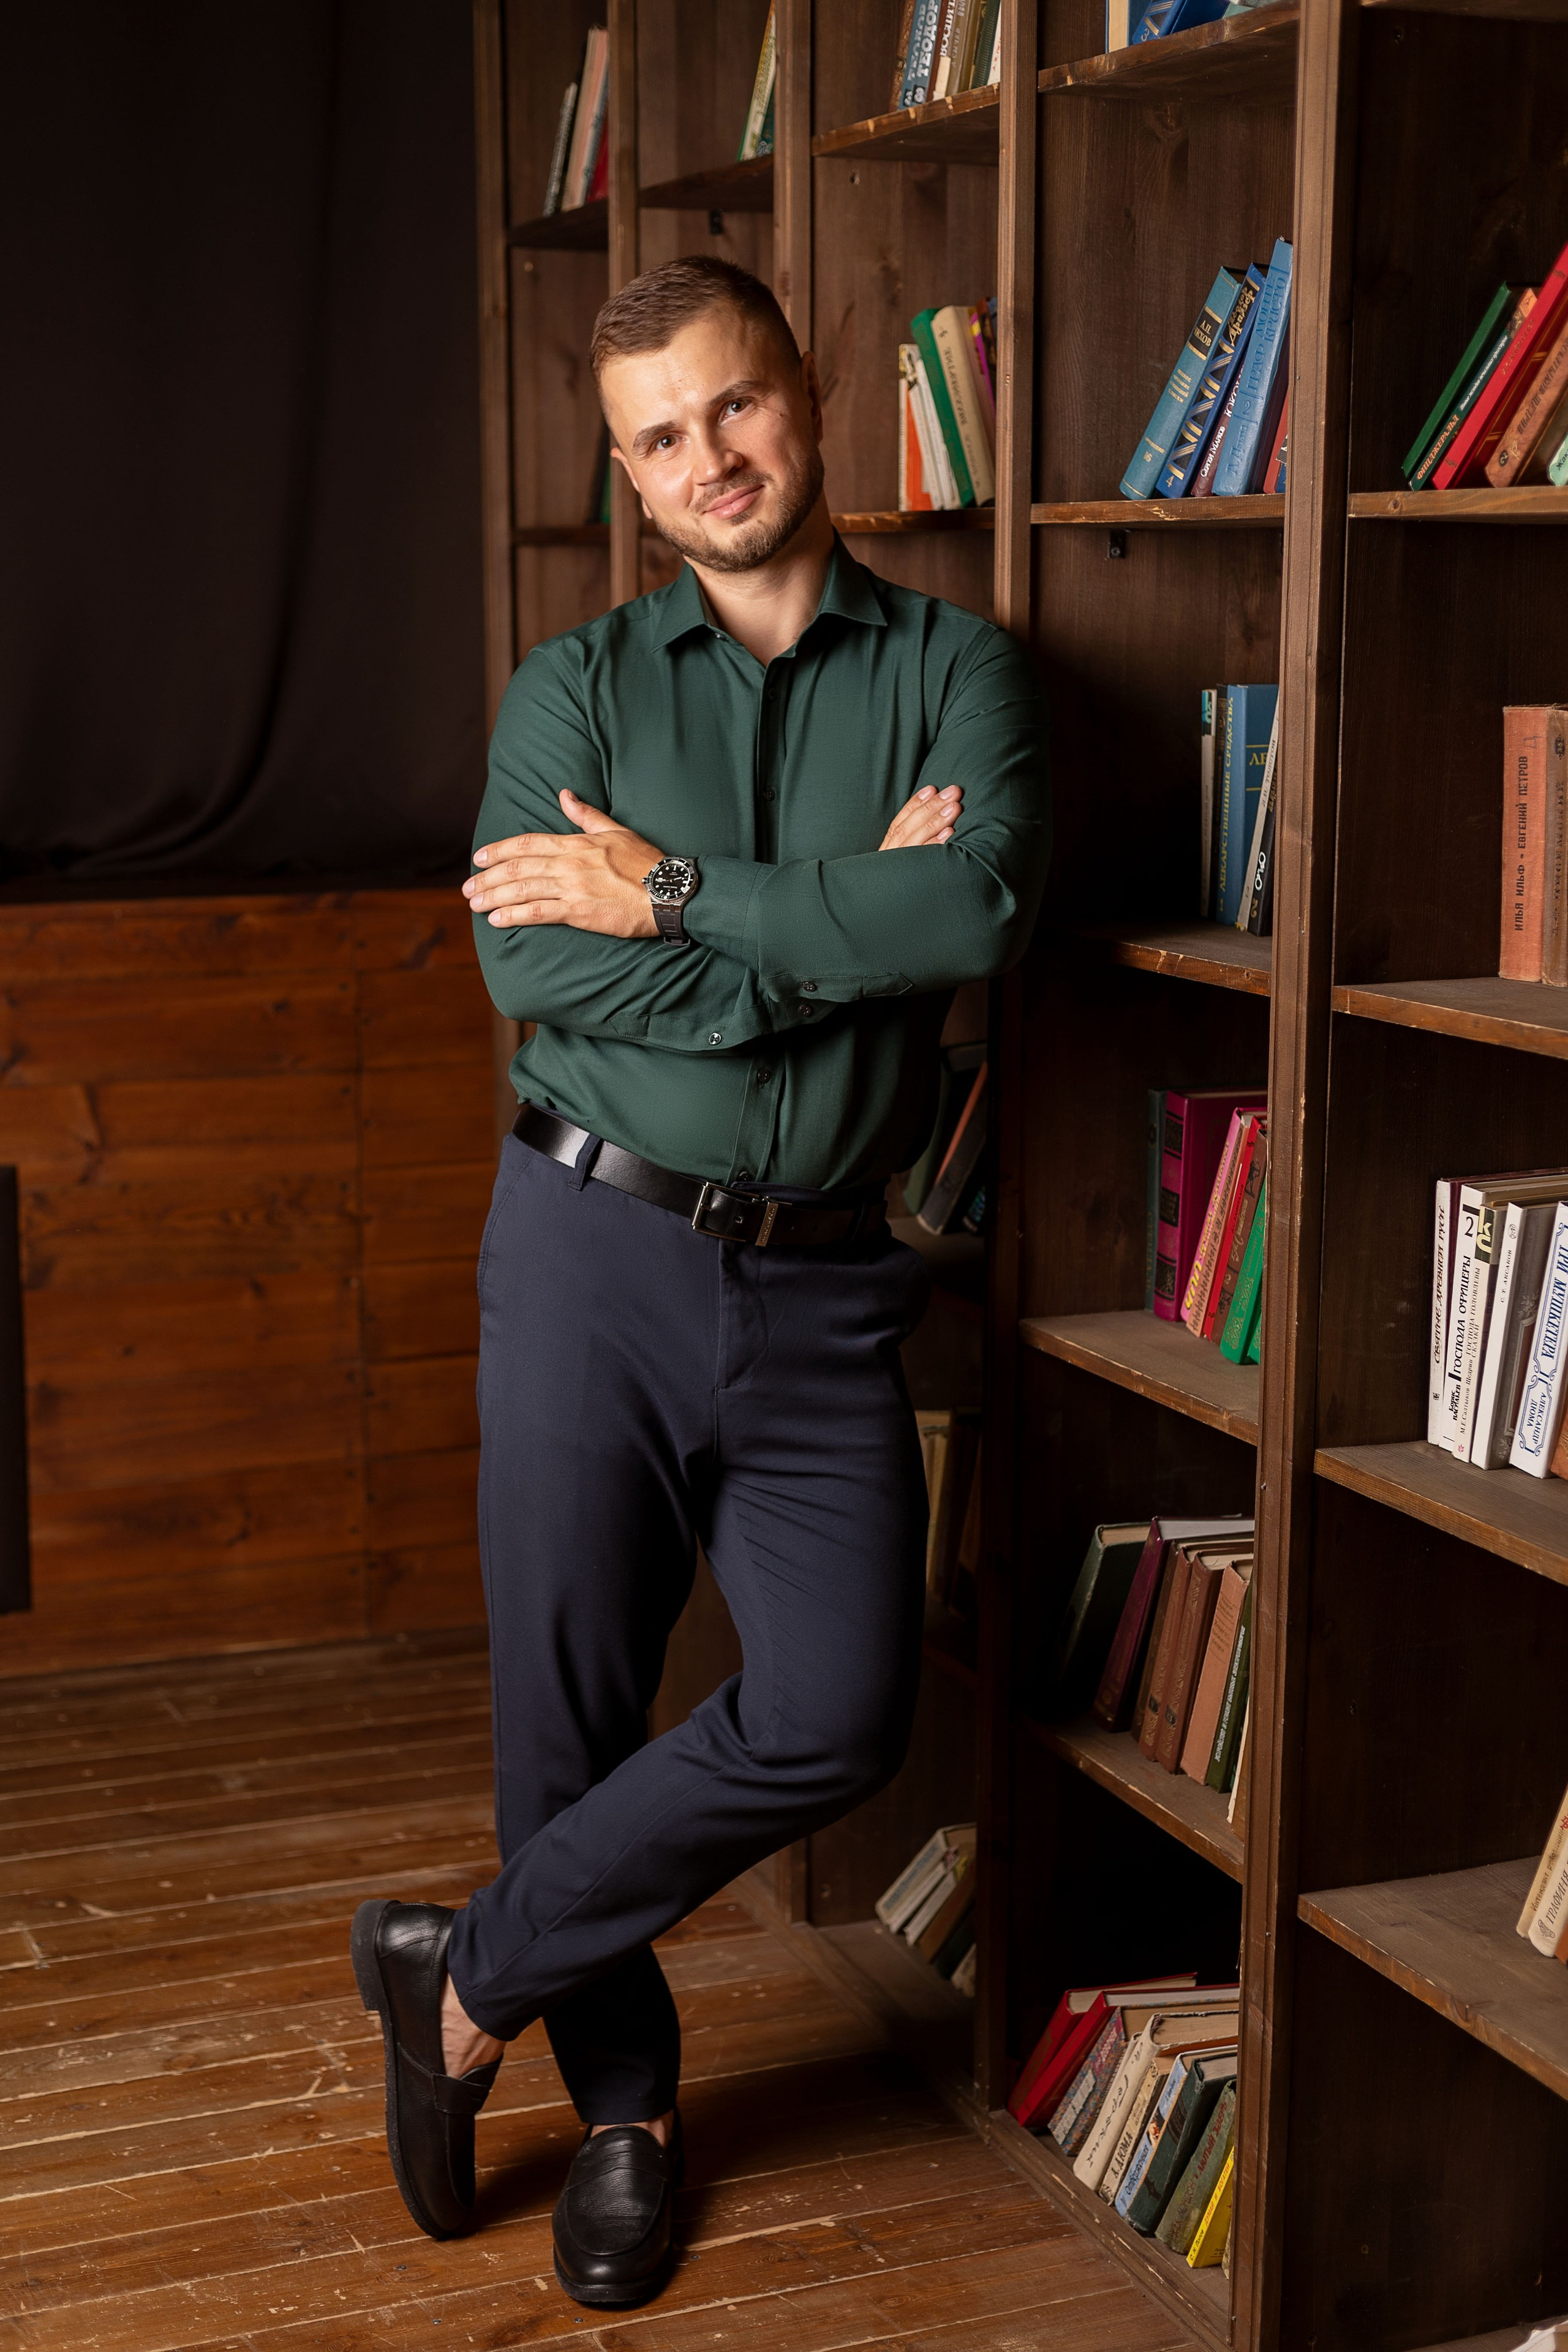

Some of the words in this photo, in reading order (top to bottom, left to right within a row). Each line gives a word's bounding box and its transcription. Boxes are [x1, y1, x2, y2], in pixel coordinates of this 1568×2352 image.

[917, 0, 938, 78] ТЕОДОР
[1200, 320, 1212, 335] А.П.
[1229, 290, 1256, 347] Драйзер
[1265, 277, 1286, 343] КРИСТО
[1246, 344, 1265, 394] ГРАФ
[1416, 414, 1460, 480] ФИЦДЖЕРАЛЬД
[1165, 476, 1174, 488] 4
[1224, 696, 1234, 768] СРЕДСТВА
[1518, 756, 1529, 797] ПЕТРОВ
[1219, 771, 1231, 891] ЛЕКАРСТВЕННЫЕ
[1517, 802, 1528, 849] ЕВГЕНИЙ
[1515, 864, 1526, 897] ИЛЬФ
[1515, 900, 1524, 932] ИЛЬЯ
[1464, 1216, 1474, 1238] 2
[1435, 1245, 1444, 1306] ДРЕВНЕЙ
[1459, 1255, 1471, 1311] ОФИЦЕРЫ
[1504, 1250, 1512, 1286] АКСАКОВ
[1466, 1319, 1474, 1355] ГОСПОДА
[1470, 1267, 1480, 1315] ГОЛОВЛЕВЫ
[1541, 1276, 1567, 1361] МУШКЕТЕРА
[1454, 1318, 1466, 1374] ГОСПОДА
[1452, 1384, 1461, 1421] ВАСИЛЬЕВ
[1526, 1398, 1537, 1428] ДЮМА
[1533, 1392, 1547, 1445] АЛЕКСАНДР
[1545, 1868, 1568, 1924] ГРАФИНЯ
[1198, 2139, 1215, 2175] ЛЮТЫЙ
[1214, 2101, 1227, 2135] ЗВЕРЬ
[1204, 2201, 1215, 2226] ДУМАЙ
[1217, 2162, 1231, 2192] БОГАТЕЙ
